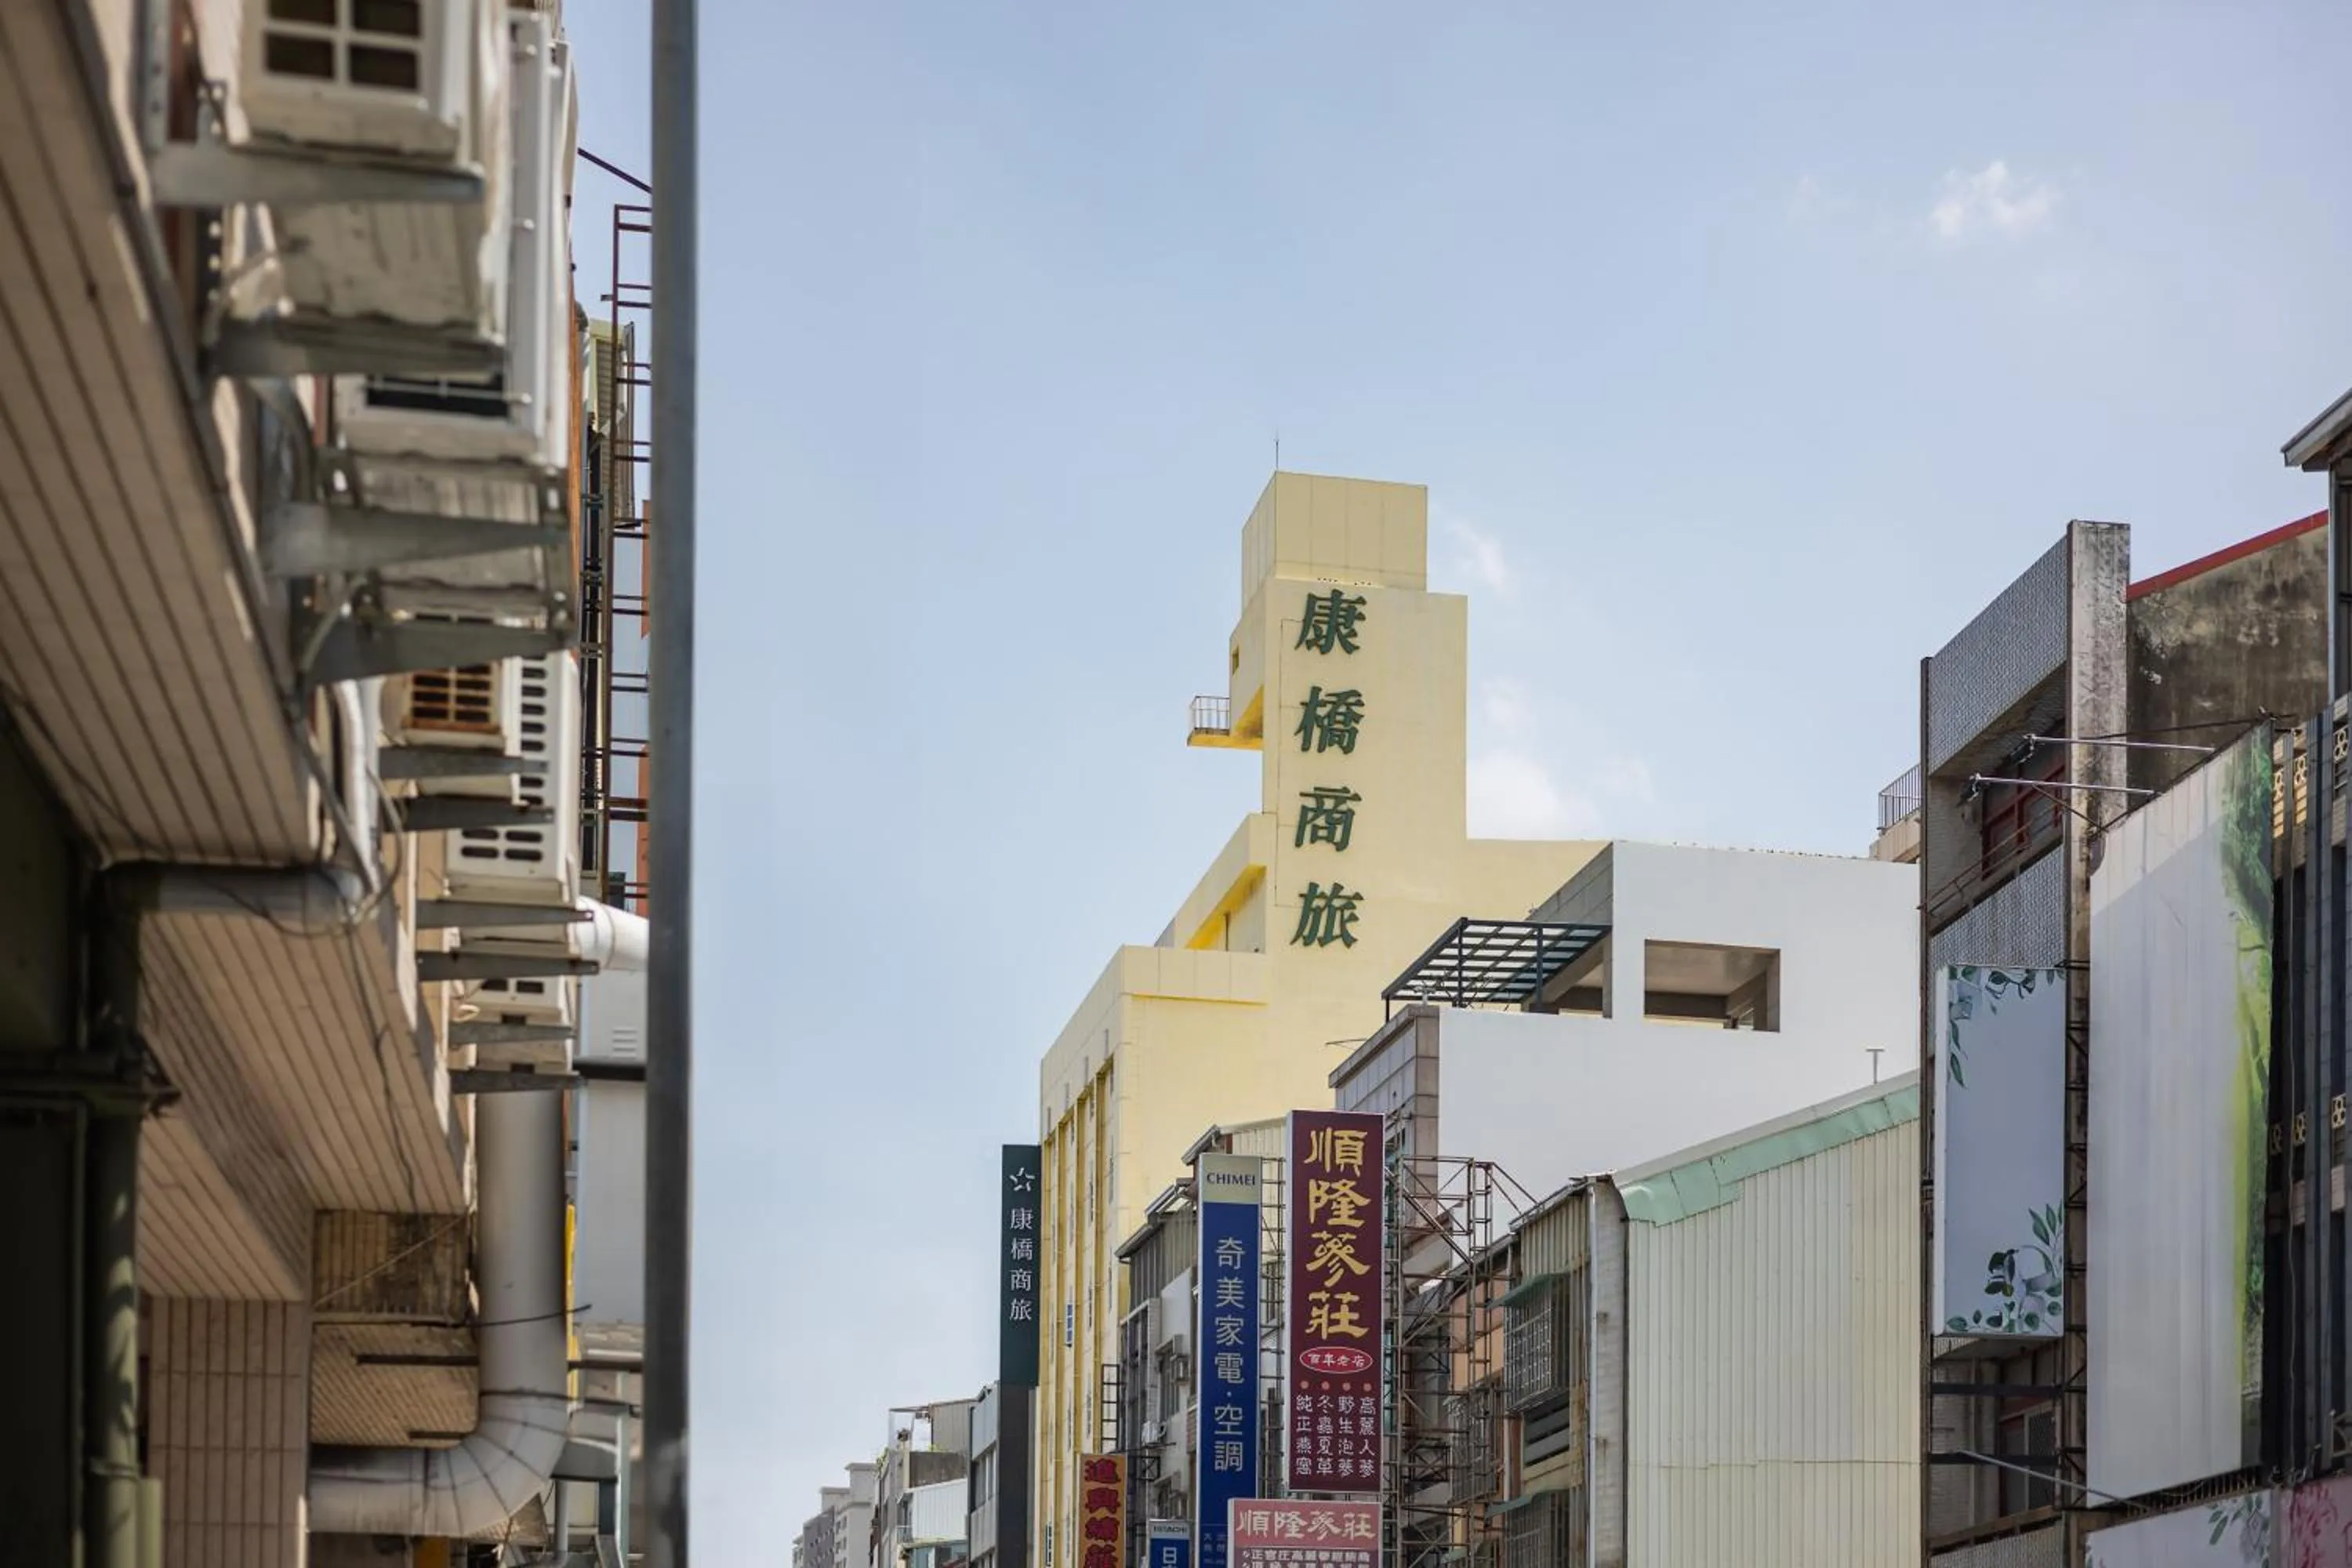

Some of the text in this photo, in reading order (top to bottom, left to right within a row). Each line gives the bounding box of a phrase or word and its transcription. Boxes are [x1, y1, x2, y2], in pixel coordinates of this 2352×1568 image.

[1290, 588, 1367, 949] 康橋商旅
[1207, 1173, 1255, 1185] CHIMEI
[1009, 1207, 1033, 1321] 康橋商旅
[1304, 1127, 1370, 1340] 順隆蔘莊
[1308, 1352, 1365, 1367] 百年老店
[1296, 1394, 1313, 1475] 純正燕窩
[1316, 1395, 1334, 1476] 冬蟲夏草
[1162, 1547, 1178, 1568] 日
[1236, 1509, 1376, 1541] 順隆蔘莊
